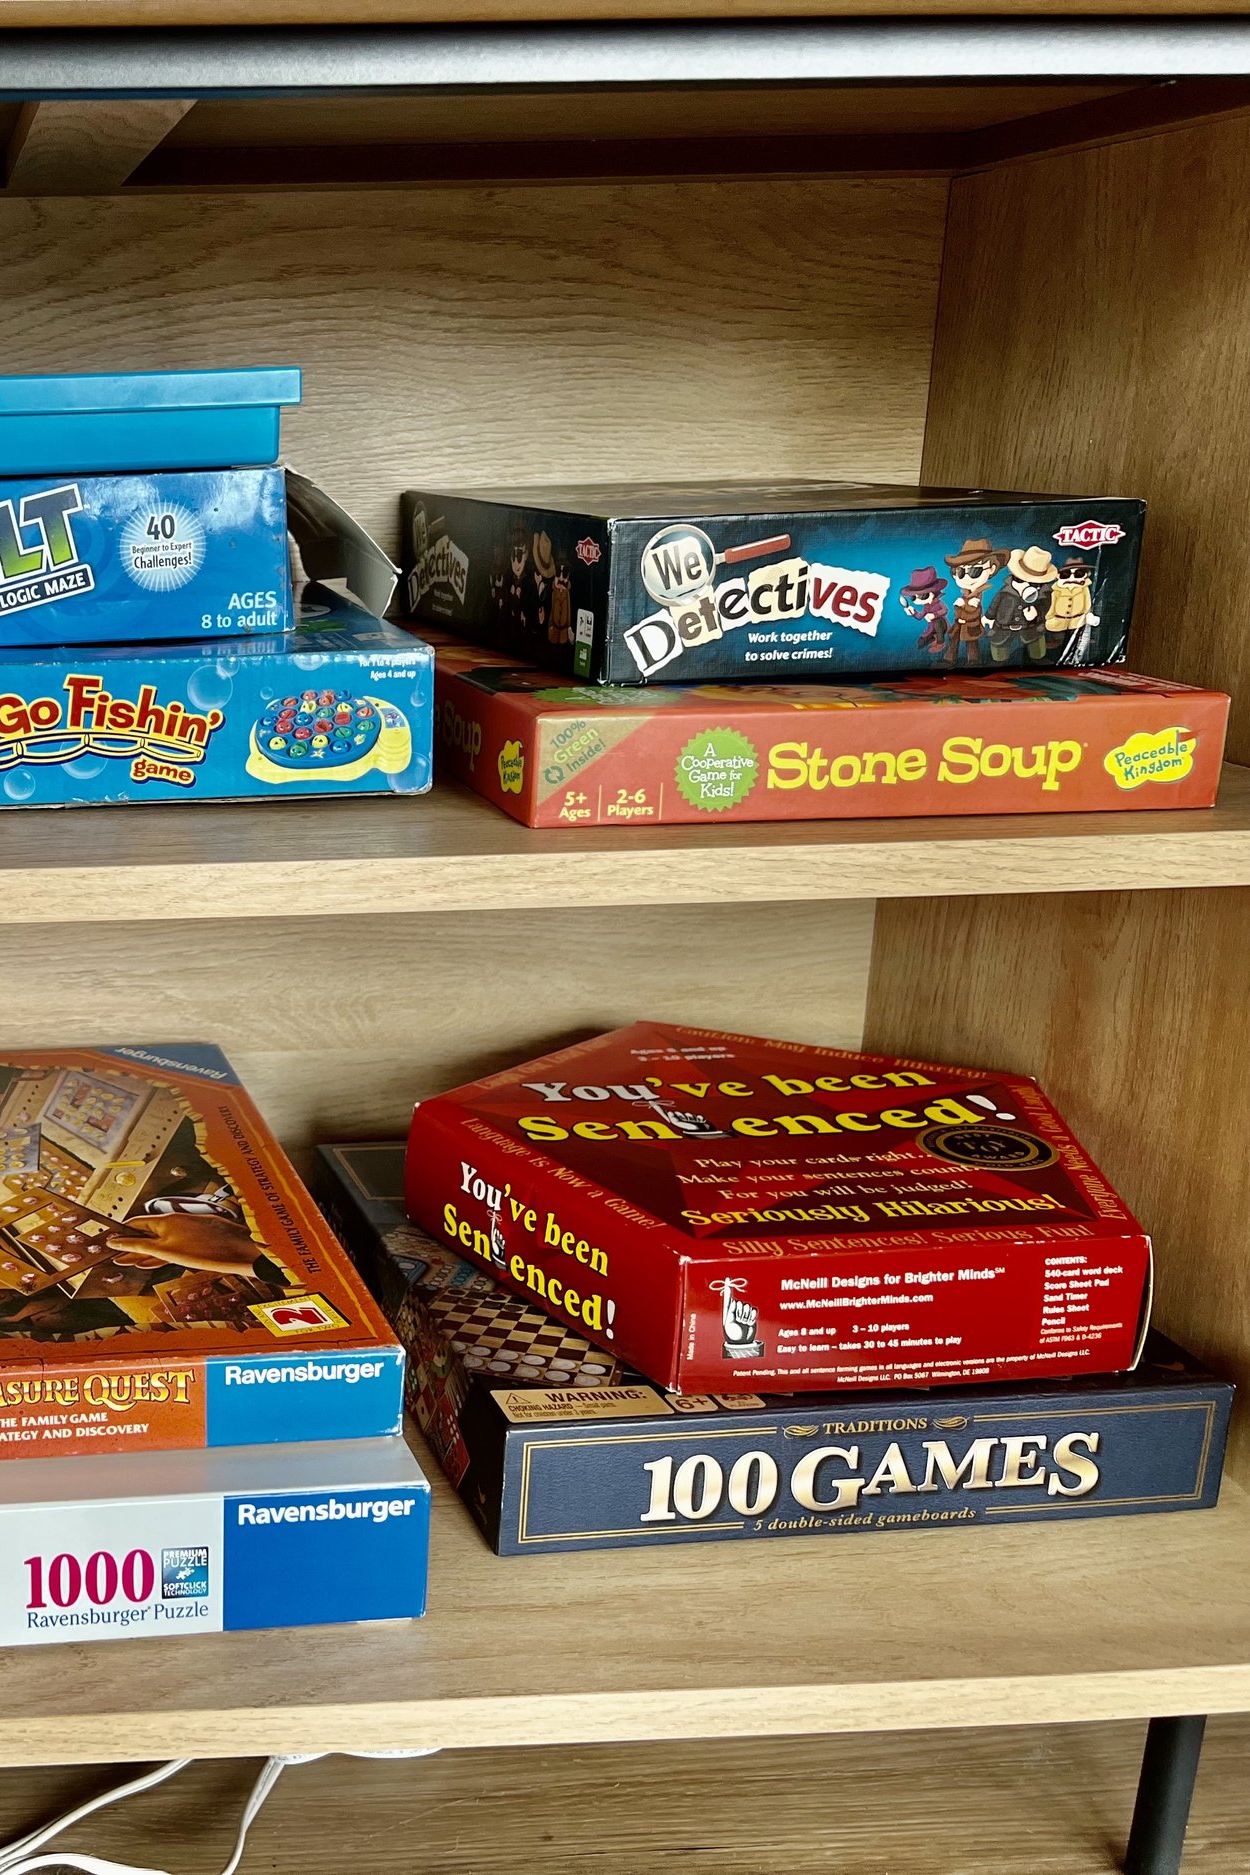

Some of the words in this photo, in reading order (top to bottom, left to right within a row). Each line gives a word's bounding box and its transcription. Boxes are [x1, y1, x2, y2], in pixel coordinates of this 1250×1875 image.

[147, 514, 175, 540] 40
[1062, 528, 1117, 542] TACTIC
[132, 545, 161, 555] Beginner
[170, 542, 192, 551] Expert
[133, 552, 192, 570] Challenges!
[652, 545, 701, 591] We
[0, 585, 41, 609] LOGIC
[44, 572, 86, 597] MAZE
[227, 590, 277, 610] AGES
[201, 614, 212, 628] 8
[216, 615, 232, 628] to
[237, 611, 277, 627] adult
[627, 565, 880, 672] Detectives
[748, 632, 778, 643] Work
[780, 630, 833, 644] together
[745, 650, 758, 661] to
[760, 650, 790, 660] solve
[791, 648, 833, 660] crimes!
[67, 676, 223, 745] Fishin'
[550, 720, 586, 748] 100%
[553, 728, 599, 764] Green
[566, 739, 606, 773] Inside!
[704, 743, 716, 757] A
[1115, 732, 1189, 768] Peaceable
[132, 759, 192, 782] game
[681, 756, 754, 771] Cooperative
[767, 741, 927, 791] Stone
[937, 736, 1082, 791] Soup
[1123, 756, 1183, 781] Kingdom
[688, 770, 727, 782] Game
[730, 770, 742, 780] for
[564, 791, 587, 806] 5+
[617, 789, 646, 804] 2-6
[700, 782, 734, 798] Kids!
[559, 807, 591, 822] Ages
[607, 804, 654, 820] Players
[114, 1047, 228, 1080] Ravensburger
[521, 1077, 754, 1102] You've
[761, 1071, 937, 1097] been
[460, 1161, 537, 1232] You've
[544, 1213, 608, 1277] been
[680, 1202, 870, 1228] Seriously
[877, 1193, 1066, 1218] Hilarious!
[722, 1239, 781, 1256] Silly
[787, 1233, 927, 1252] Sentences!
[934, 1226, 1034, 1246] Serious
[1040, 1224, 1096, 1239] Fun!
[781, 1277, 828, 1290] McNeill
[832, 1275, 879, 1289] Designs
[884, 1273, 901, 1285] for
[905, 1271, 954, 1285] Brighter
[779, 1294, 933, 1310] www.McNeillBrighterMinds.com
[224, 1360, 384, 1386] Ravensburger
[83, 1368, 196, 1411] QUEST
[545, 1390, 647, 1403] WARNING:
[675, 1398, 708, 1409] 6+
[21, 1414, 67, 1427] FAMILY
[69, 1411, 108, 1424] GAME
[43, 1427, 72, 1440] AND
[75, 1422, 150, 1438] DISCOVERY
[823, 1417, 927, 1436] TRADITIONS
[641, 1450, 778, 1521] 100
[790, 1431, 1100, 1512] GAMES
[238, 1497, 415, 1526] Ravensburger
[754, 1519, 764, 1532] 5
[766, 1511, 872, 1530] double-sided
[876, 1507, 977, 1526] gameboards
[23, 1549, 155, 1609] 1000
[27, 1605, 148, 1629] Ravensburger
[153, 1601, 209, 1622] Puzzle
